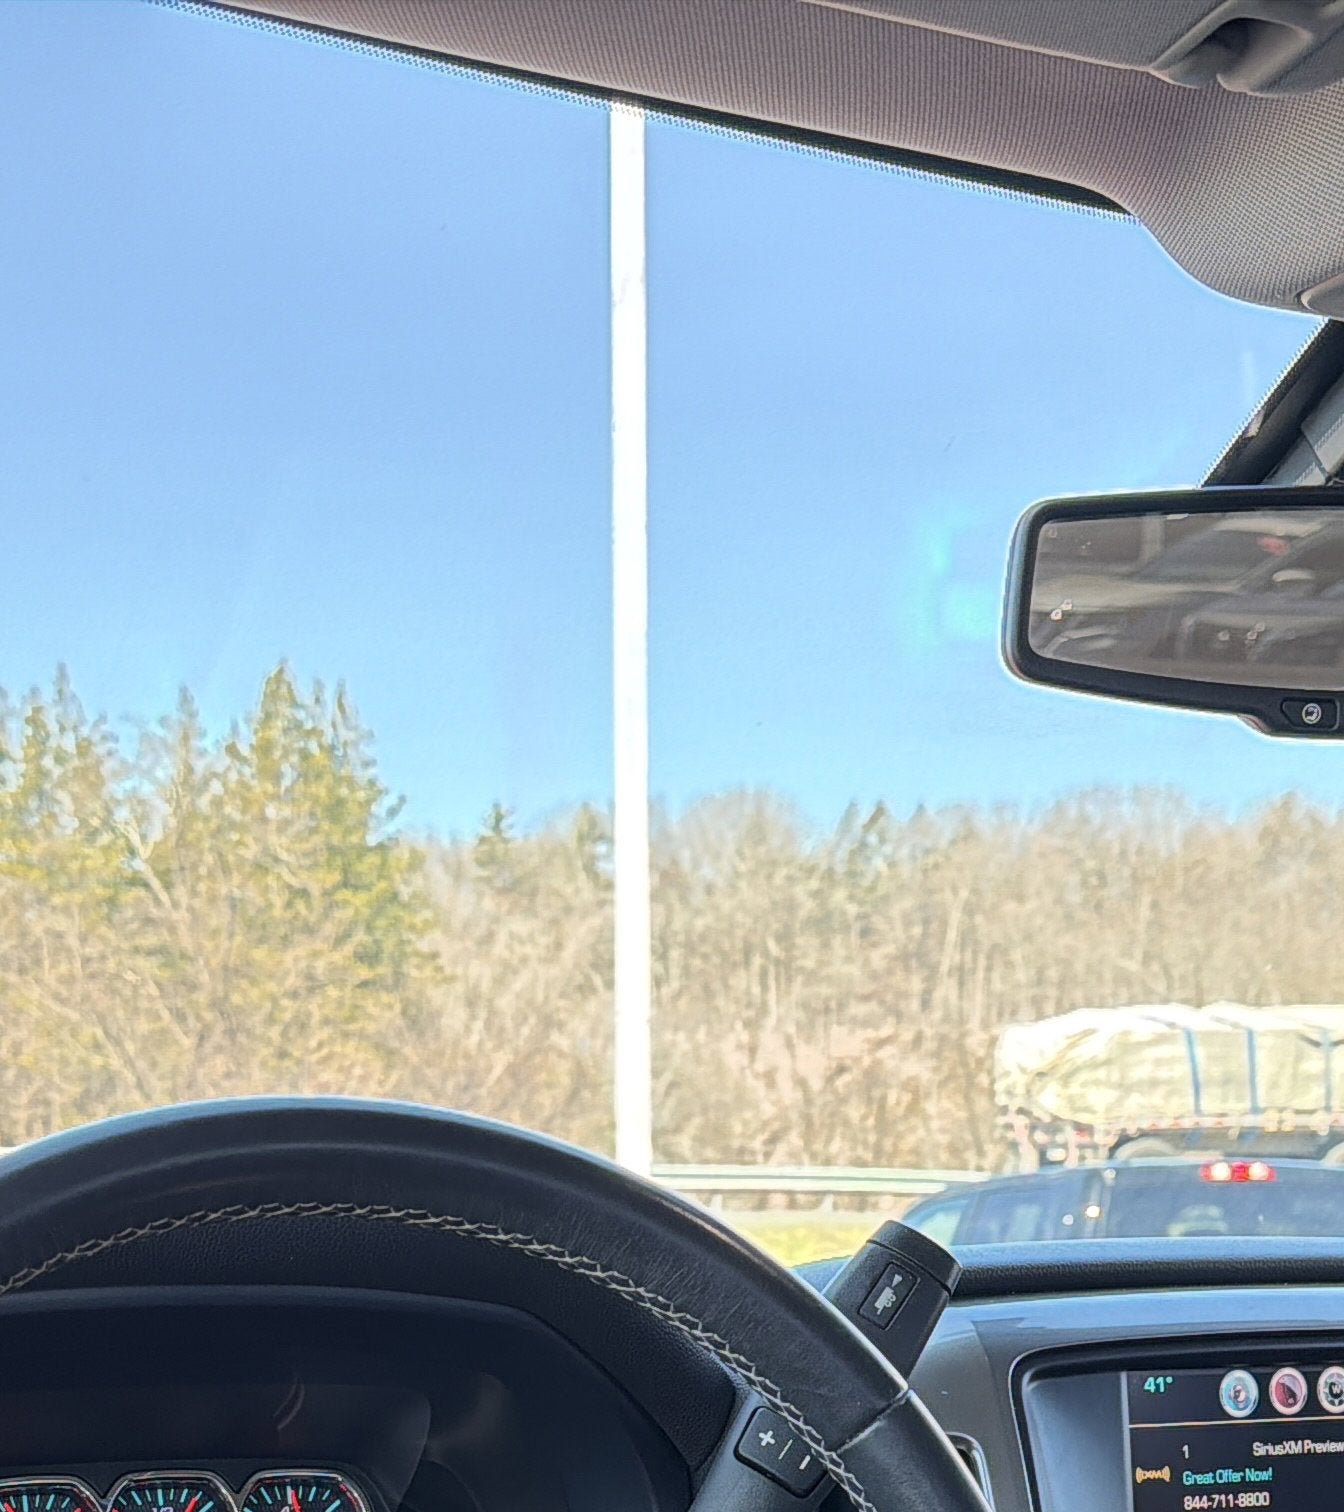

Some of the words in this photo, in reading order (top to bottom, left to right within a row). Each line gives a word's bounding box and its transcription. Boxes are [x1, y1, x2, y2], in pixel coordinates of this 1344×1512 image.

[1144, 1376, 1173, 1393] 41°
[1182, 1444, 1190, 1459] 1
[1252, 1440, 1303, 1456] SiriusXM
[1182, 1471, 1215, 1485] Great
[1216, 1469, 1244, 1483] Offer
[1245, 1467, 1273, 1481] Now!
[1183, 1491, 1270, 1511] 844-711-8800
